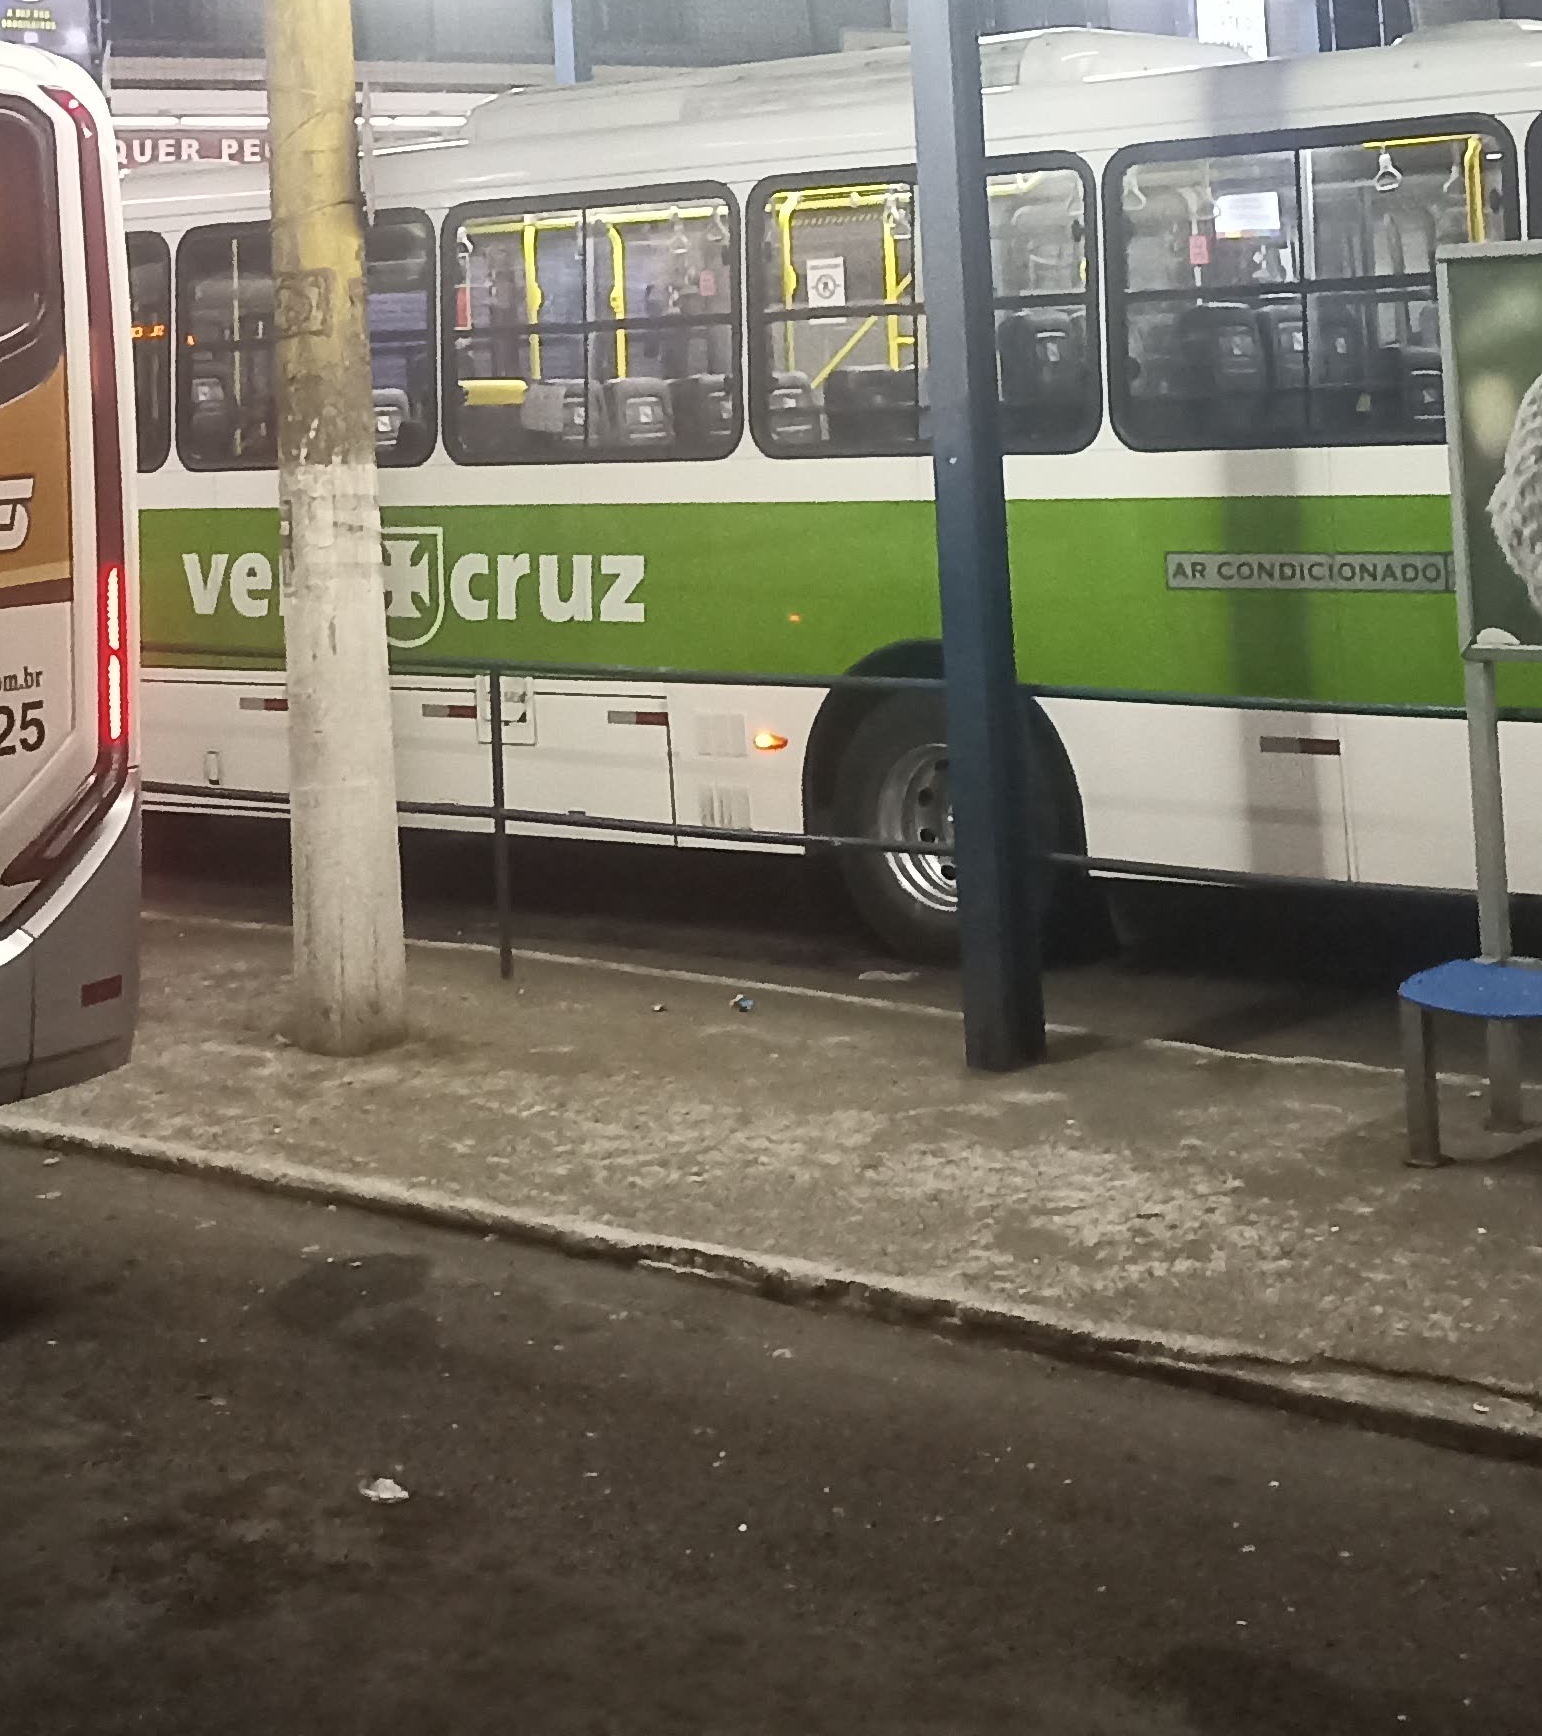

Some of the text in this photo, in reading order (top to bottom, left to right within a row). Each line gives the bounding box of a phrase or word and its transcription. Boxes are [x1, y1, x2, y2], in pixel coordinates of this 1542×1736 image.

[450, 552, 647, 624] cruz
[1170, 559, 1443, 584] AR CONDICIONADO
